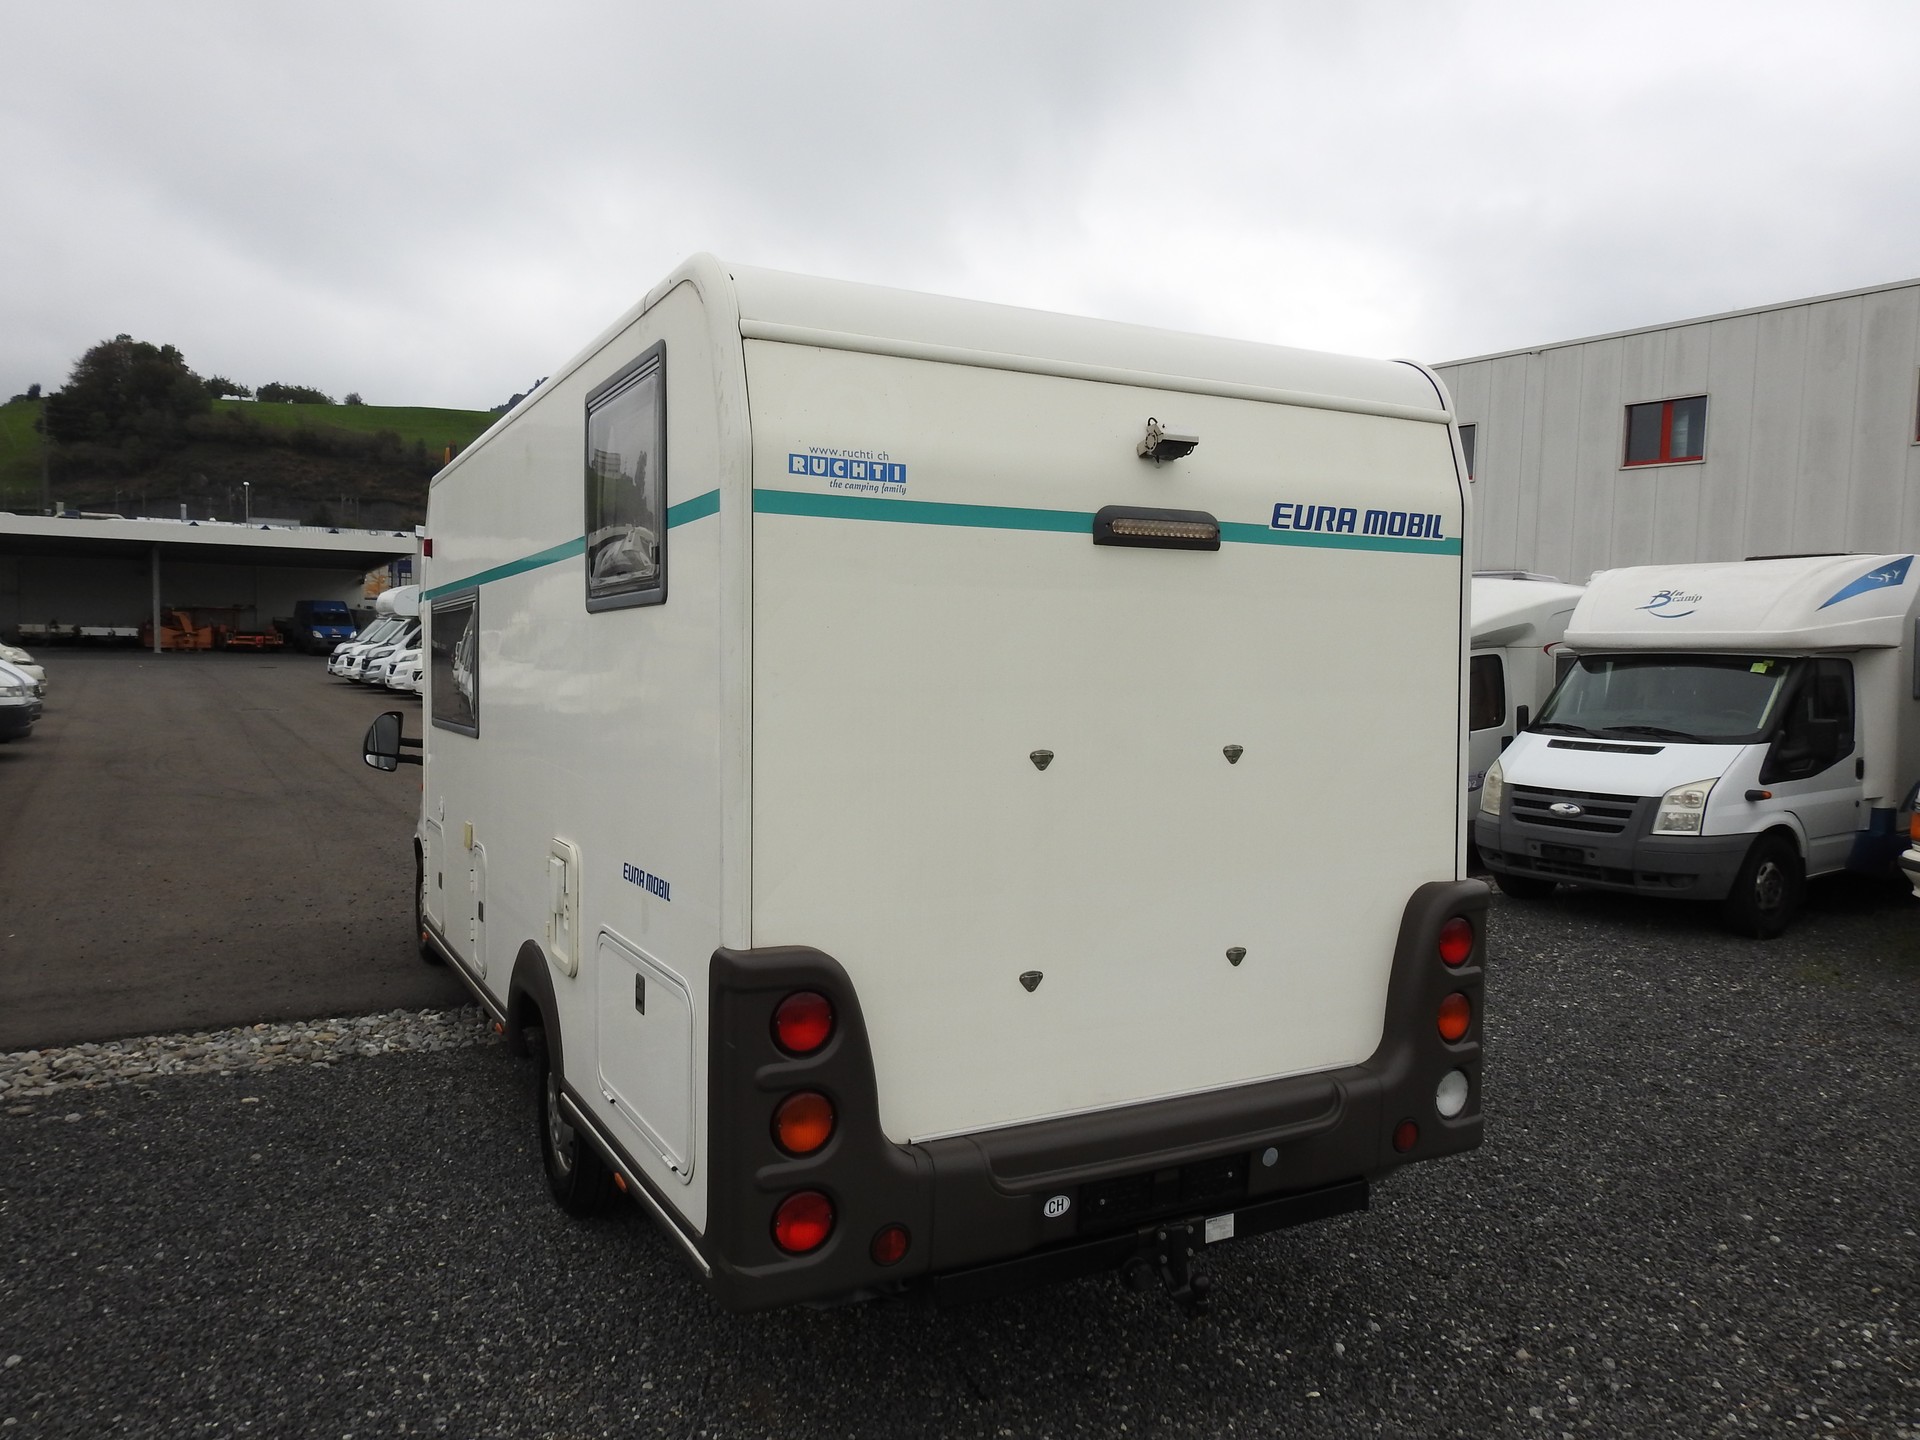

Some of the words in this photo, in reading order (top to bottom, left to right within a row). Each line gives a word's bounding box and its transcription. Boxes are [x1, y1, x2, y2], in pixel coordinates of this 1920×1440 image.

[792, 456, 901, 481] RUCHTI
[829, 479, 843, 489] the
[844, 481, 879, 493] camping
[881, 483, 907, 496] family
[1271, 502, 1358, 533] EURA
[1362, 509, 1444, 539] MOBIL
[623, 862, 645, 888] EURA
[646, 873, 671, 902] MOBIL
[1049, 1198, 1064, 1214] CH
